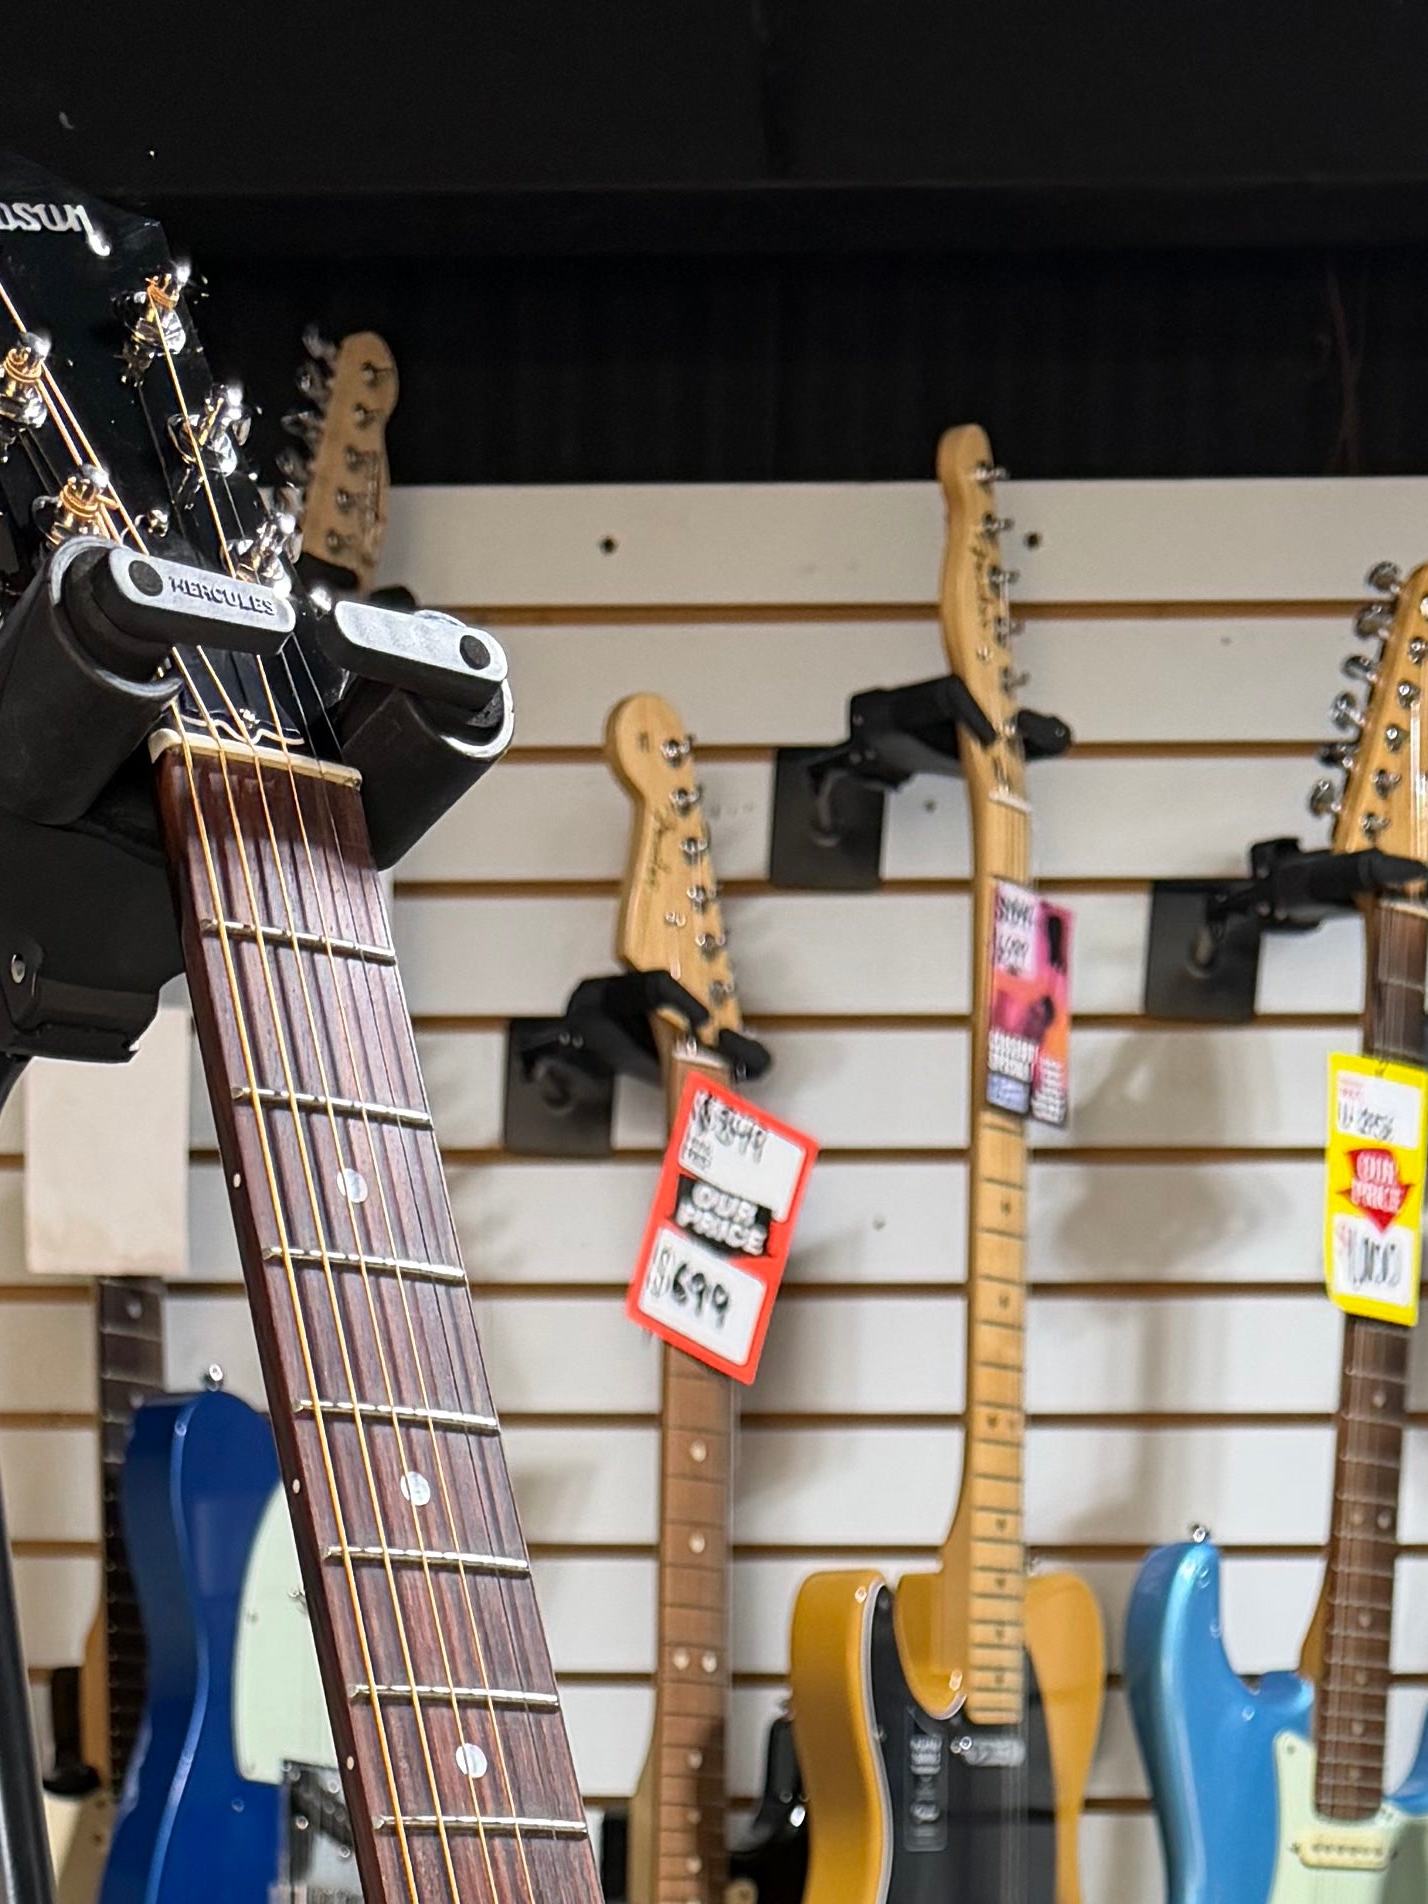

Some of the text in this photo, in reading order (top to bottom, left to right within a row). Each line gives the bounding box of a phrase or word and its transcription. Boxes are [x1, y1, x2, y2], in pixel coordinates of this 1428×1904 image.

[169, 574, 276, 618] HERCULES
[676, 1198, 769, 1257] PRICE
[692, 1180, 758, 1228] OUR
